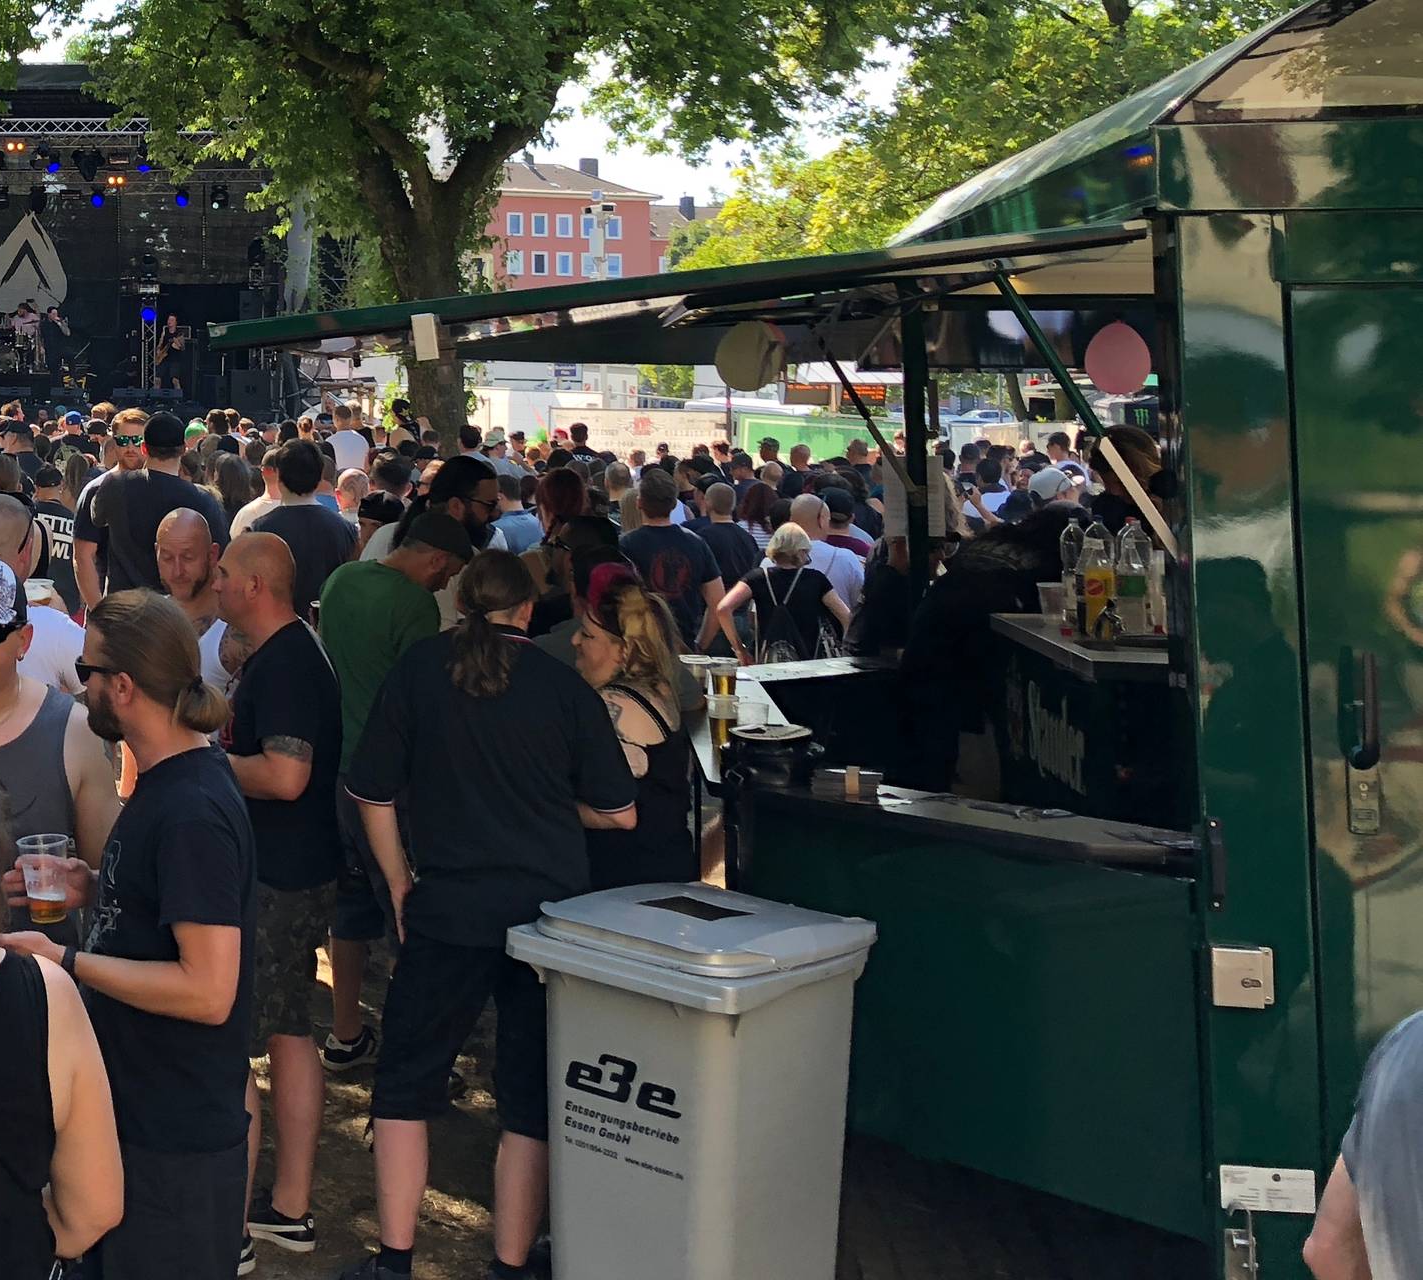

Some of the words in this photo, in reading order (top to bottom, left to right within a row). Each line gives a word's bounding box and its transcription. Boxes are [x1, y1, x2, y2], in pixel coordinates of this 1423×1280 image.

[564, 1099, 680, 1145] Entsorgungsbetriebe
[564, 1115, 597, 1135] Essen
[598, 1127, 632, 1145] GmbH
